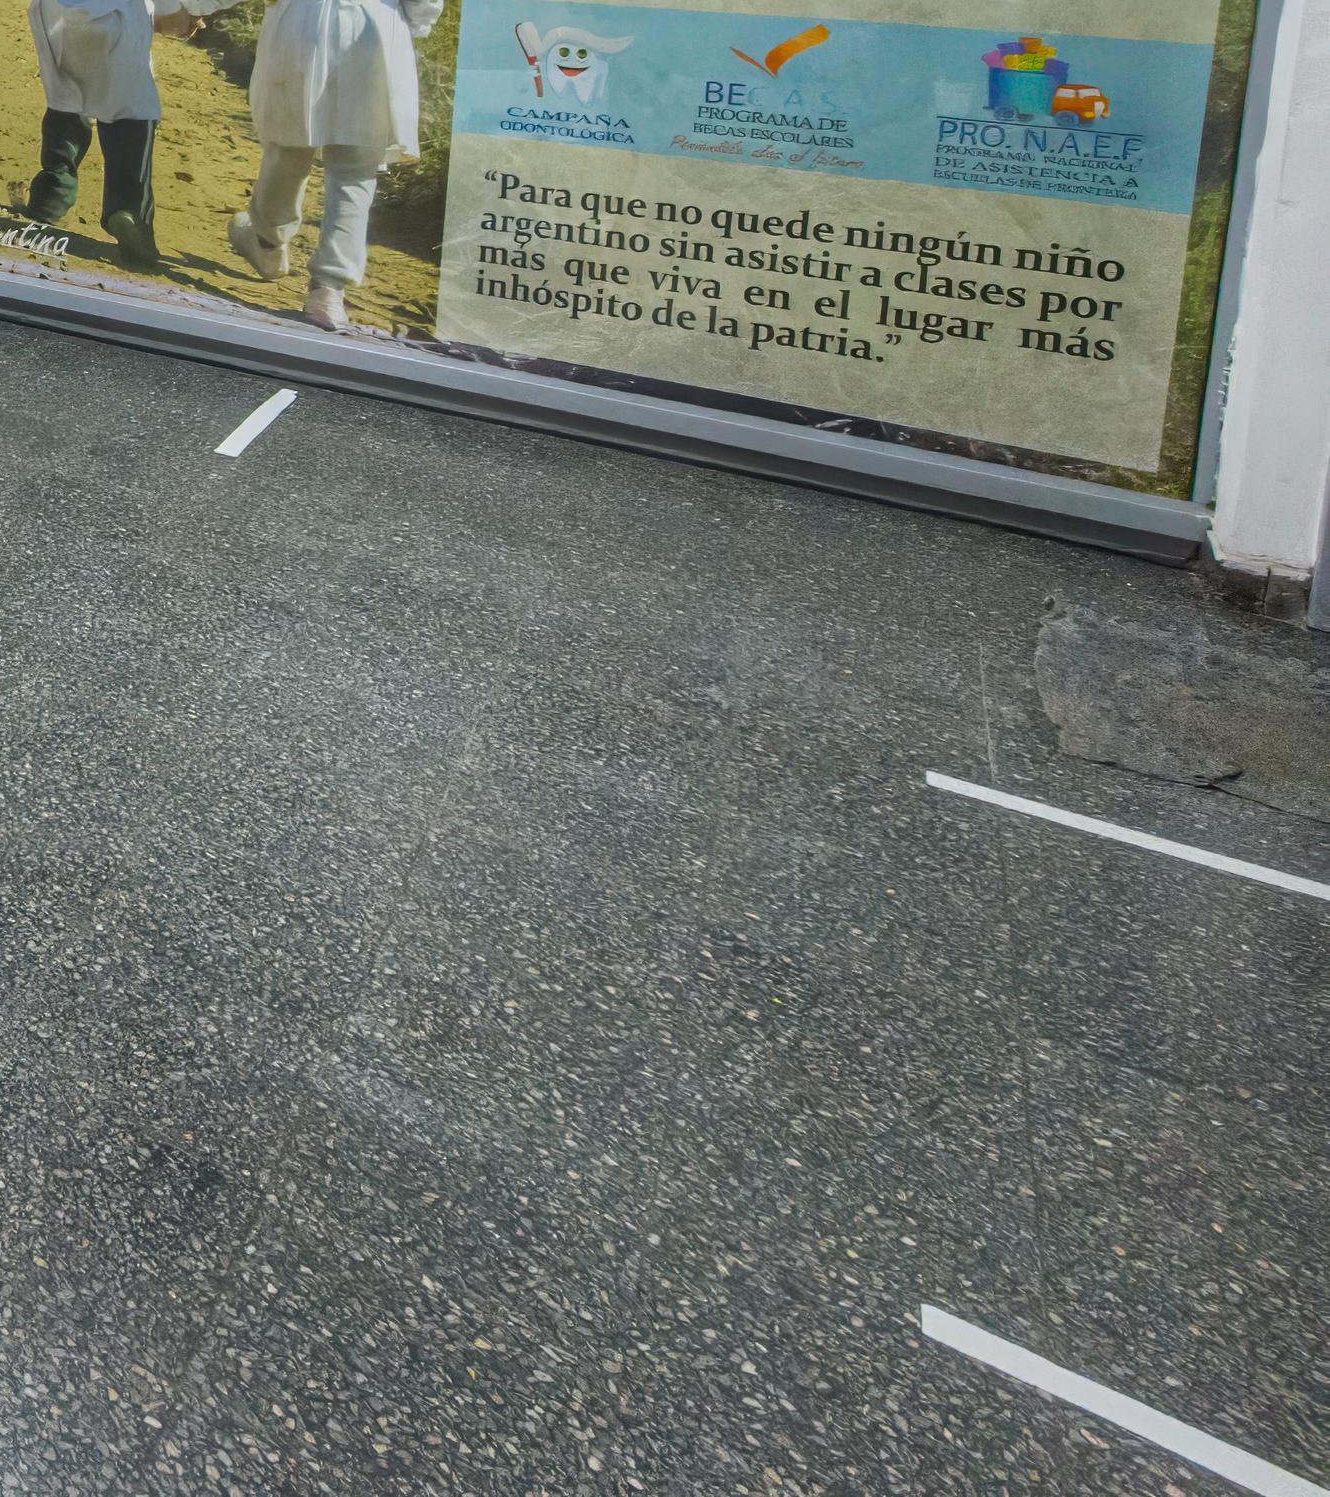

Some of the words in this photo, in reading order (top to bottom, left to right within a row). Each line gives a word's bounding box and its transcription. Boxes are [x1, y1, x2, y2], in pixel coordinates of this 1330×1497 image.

[507, 107, 630, 129] CAMPAÑA
[693, 122, 745, 137] BECAS
[750, 128, 854, 149] ESCOLARES
[698, 105, 812, 129] PROGRAMA
[817, 117, 848, 132] DE
[935, 156, 965, 169] DE
[972, 159, 1116, 188] ASISTENCIA
[1124, 177, 1139, 189] A
[580, 192, 647, 220] que
[654, 202, 703, 225] no
[710, 208, 834, 243] quede
[844, 220, 1004, 267] ningún
[1012, 242, 1125, 282] niño
[481, 211, 650, 253] argentino
[659, 231, 715, 264] sin
[724, 244, 852, 282] asistir
[859, 266, 883, 288] a
[893, 261, 1027, 308] clases
[1036, 290, 1123, 322] por
[476, 269, 643, 321] inhóspito
[651, 298, 697, 331] de
[707, 305, 740, 339] la
[478, 242, 546, 271] más
[564, 257, 630, 286] que
[648, 265, 722, 300] viva
[743, 285, 791, 311] en
[813, 289, 851, 320] el
[875, 295, 995, 343] lugar
[1018, 326, 1116, 362] más
